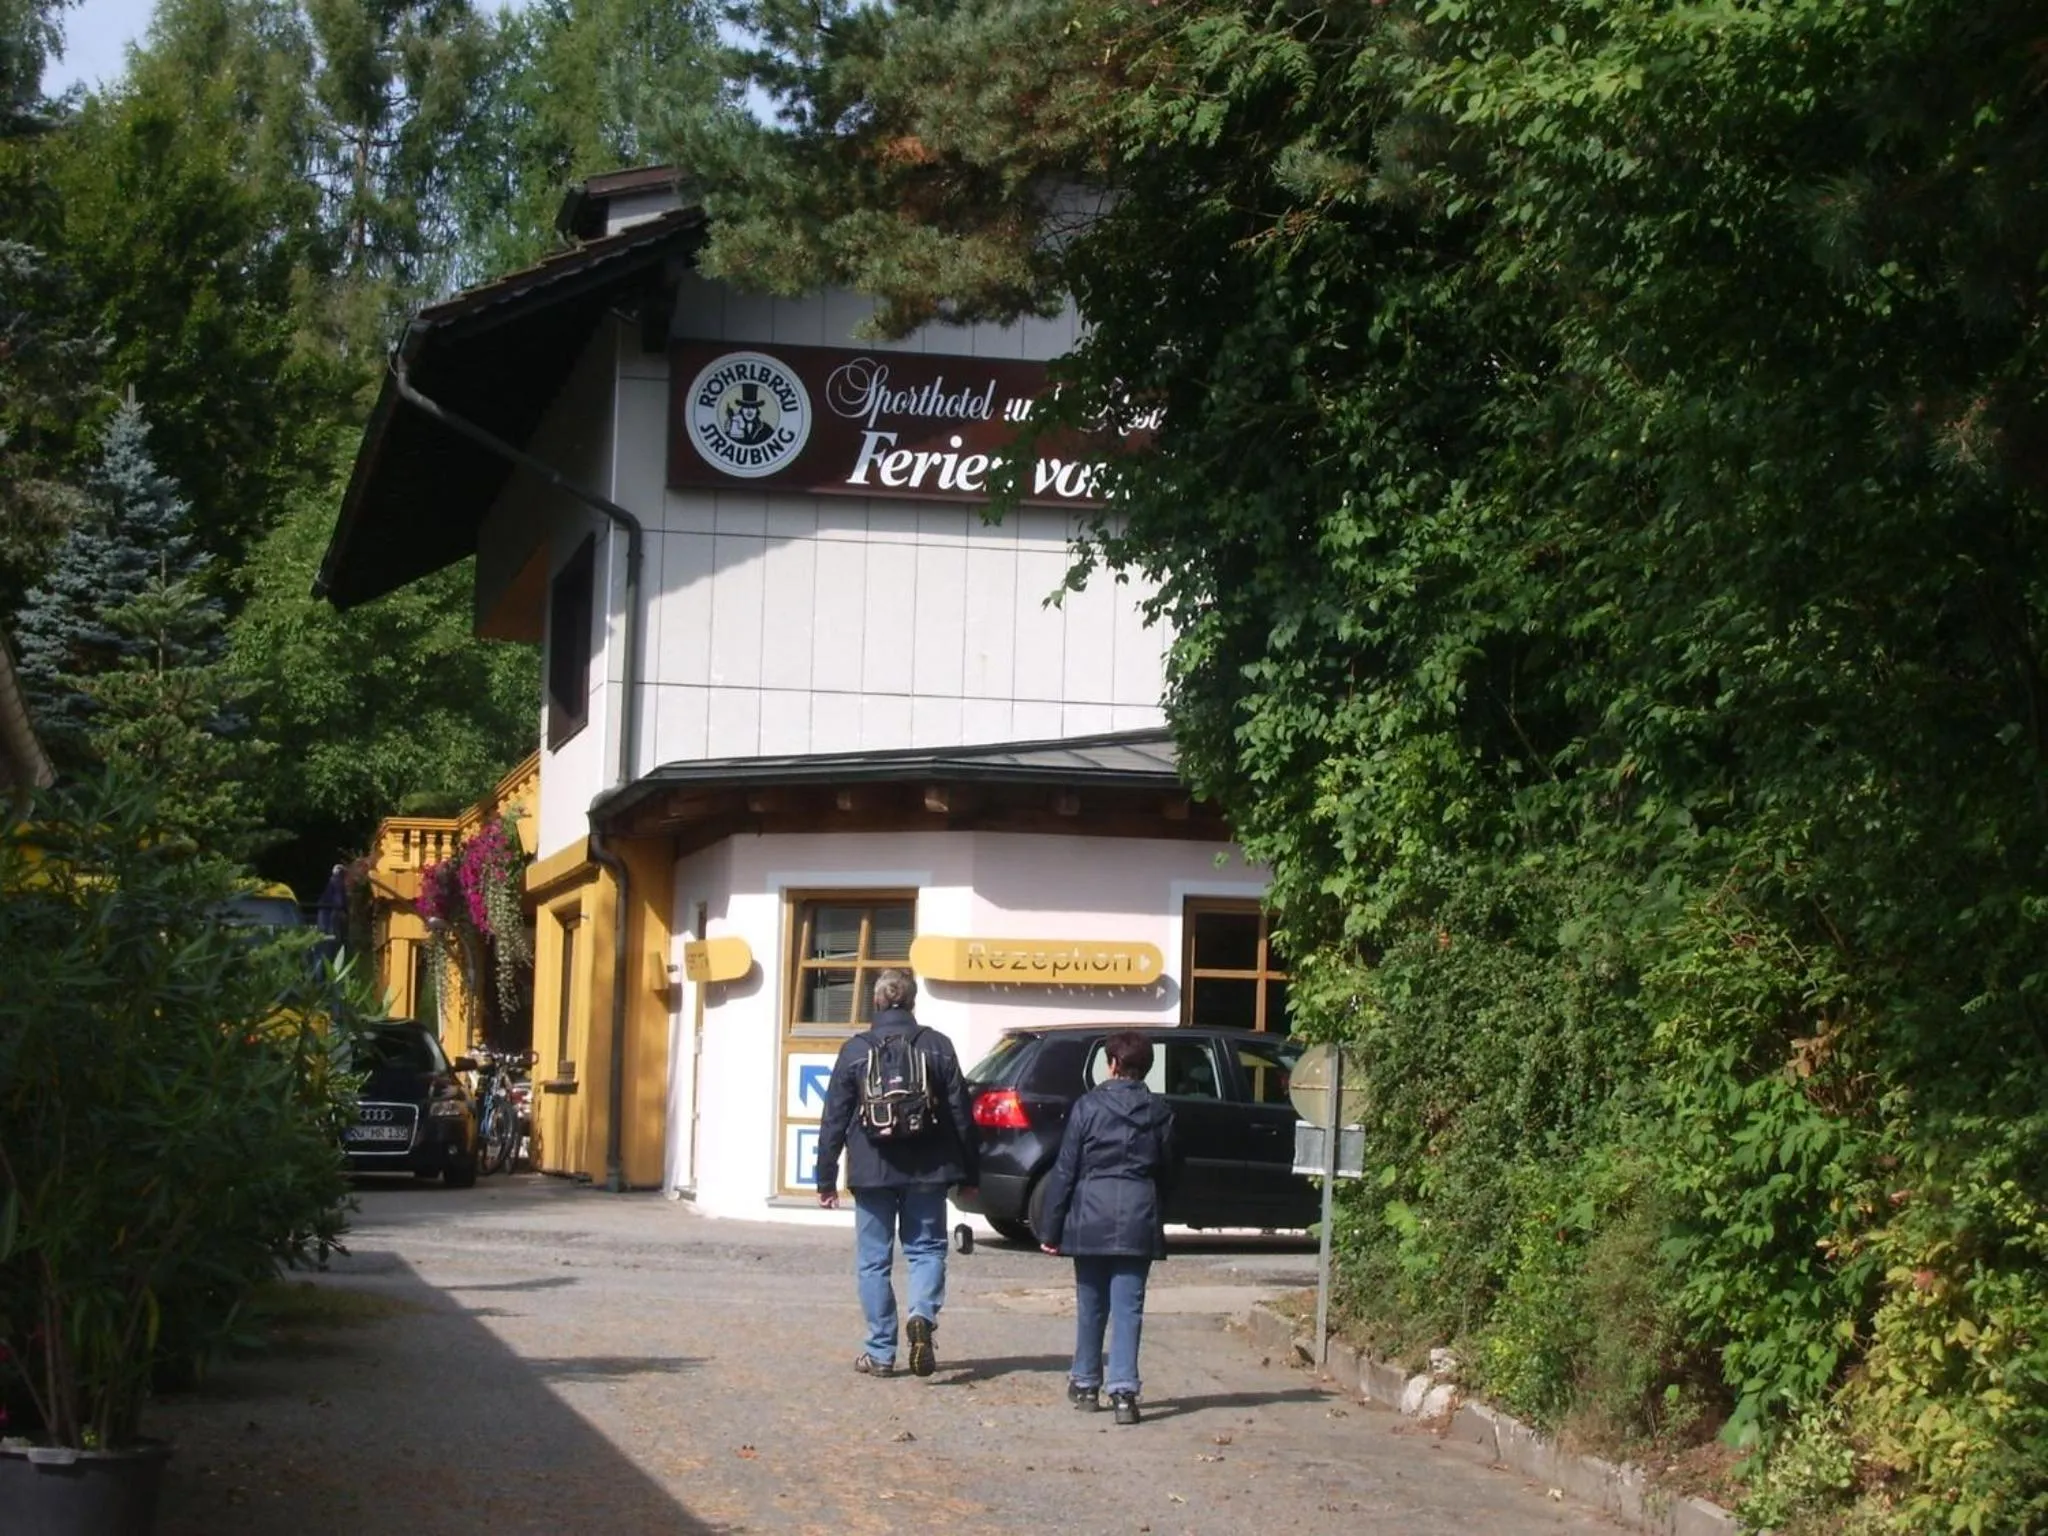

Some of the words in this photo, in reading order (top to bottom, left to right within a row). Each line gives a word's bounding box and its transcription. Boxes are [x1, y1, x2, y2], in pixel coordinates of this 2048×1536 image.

[698, 363, 799, 413] RÖHRLBRÄU
[826, 356, 997, 429] Sporthotel
[699, 423, 796, 465] STRAUBING
[967, 943, 1132, 978] Rezeption
